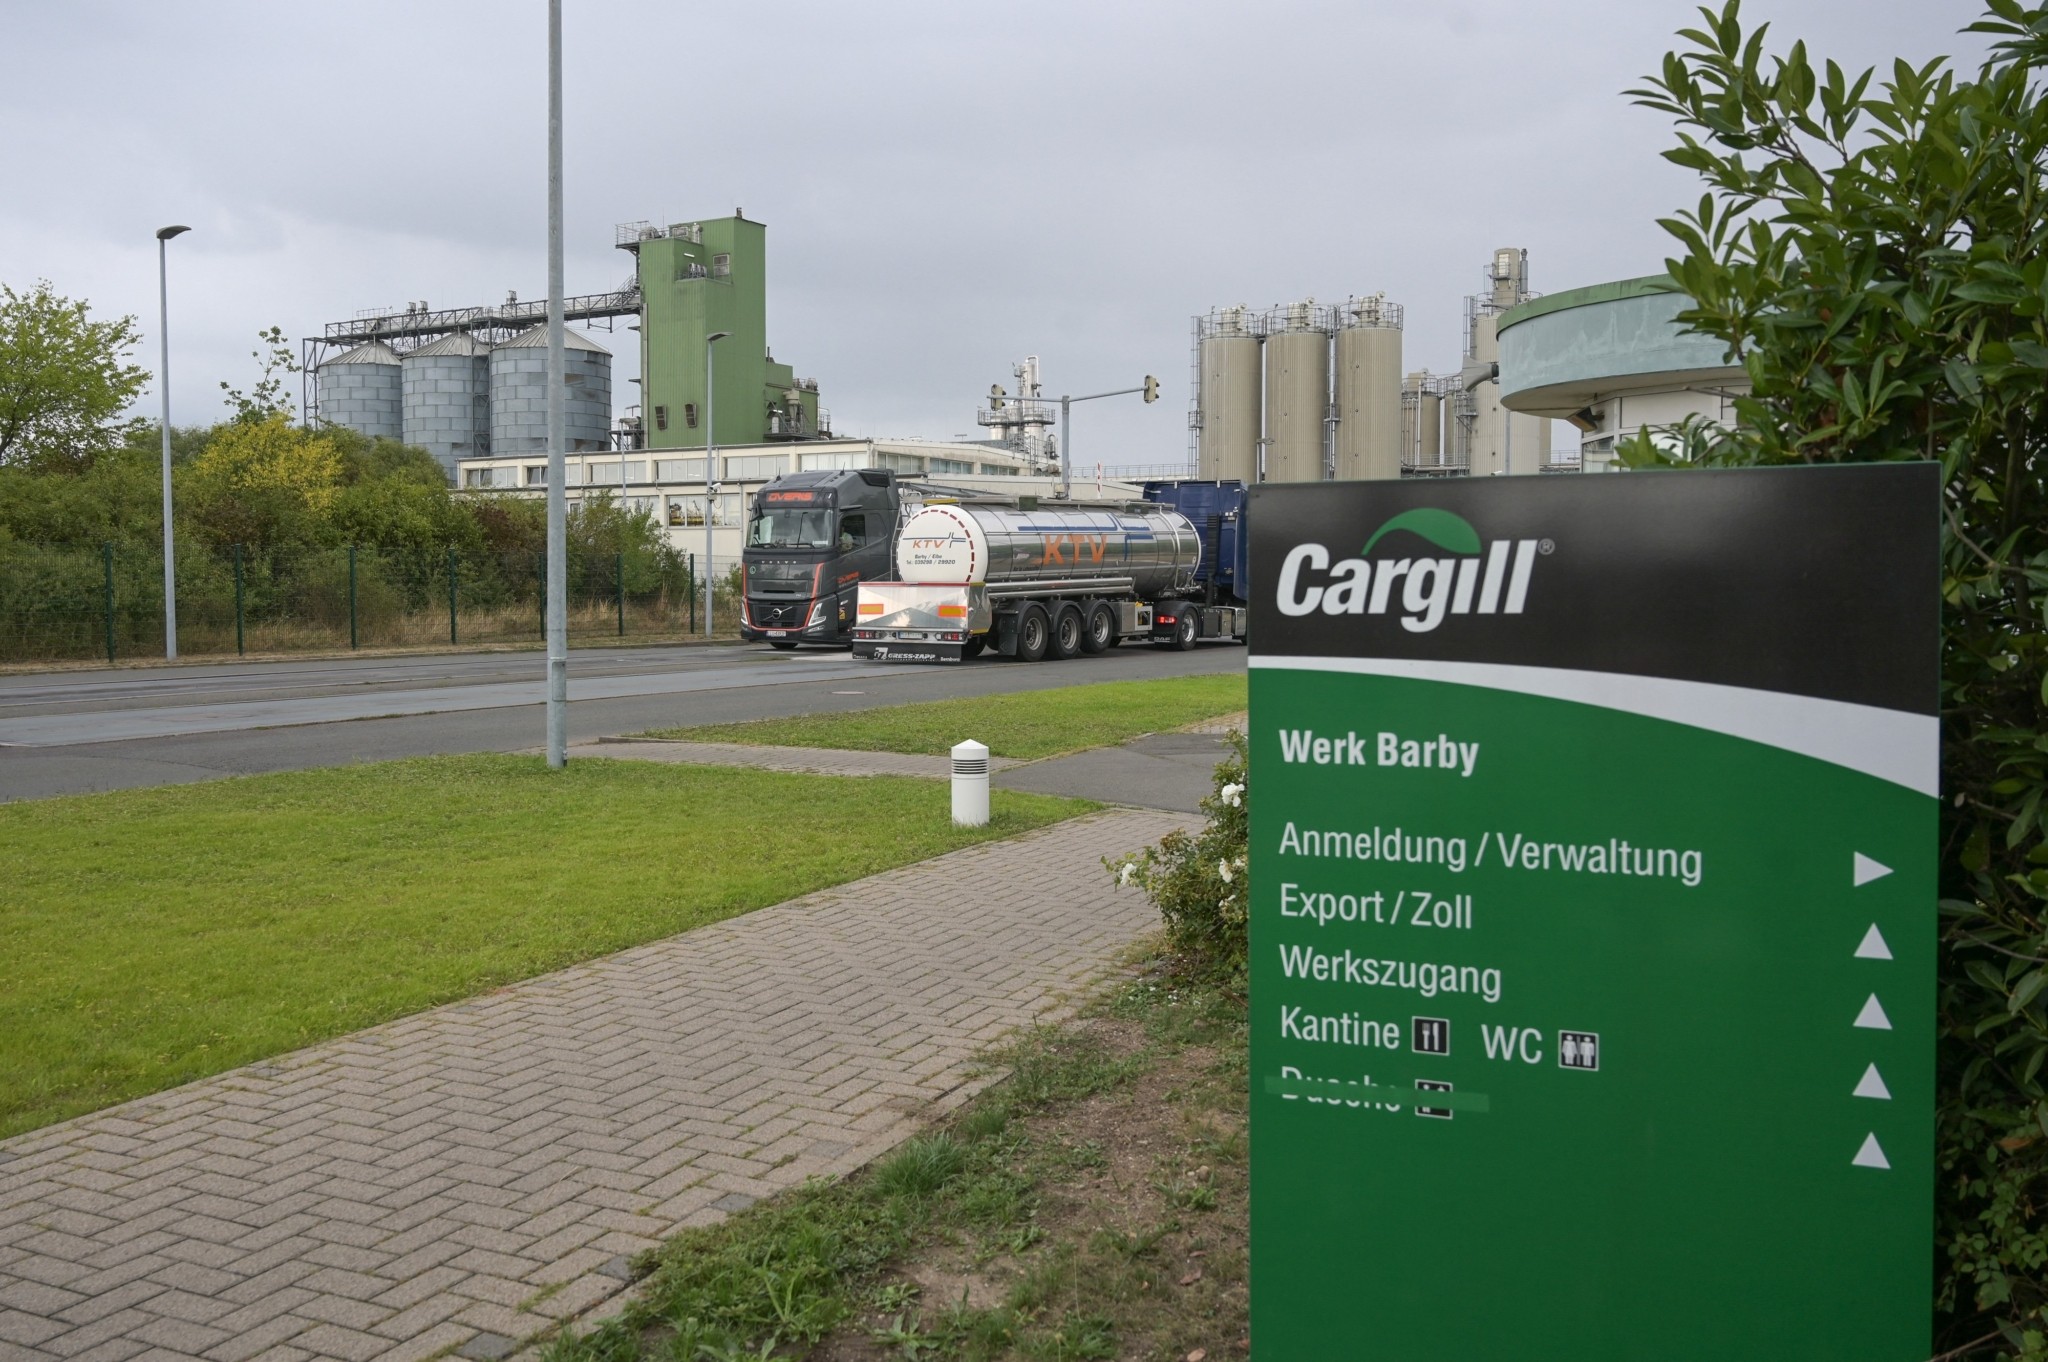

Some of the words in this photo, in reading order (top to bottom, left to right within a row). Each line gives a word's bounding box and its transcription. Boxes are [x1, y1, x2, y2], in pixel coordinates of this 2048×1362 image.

[912, 539, 945, 549] KTV
[1042, 533, 1108, 566] KTV
[1276, 539, 1538, 633] Cargill
[1278, 729, 1366, 766] Werk
[1377, 731, 1480, 778] Barby
[1278, 821, 1466, 873] Anmeldung
[1496, 832, 1702, 887] Verwaltung
[1280, 882, 1384, 927] Export
[1410, 891, 1472, 929] Zoll
[1279, 943, 1501, 1003] Werkszugang
[1281, 1005, 1400, 1050] Kantine
[1481, 1024, 1542, 1064] WC
